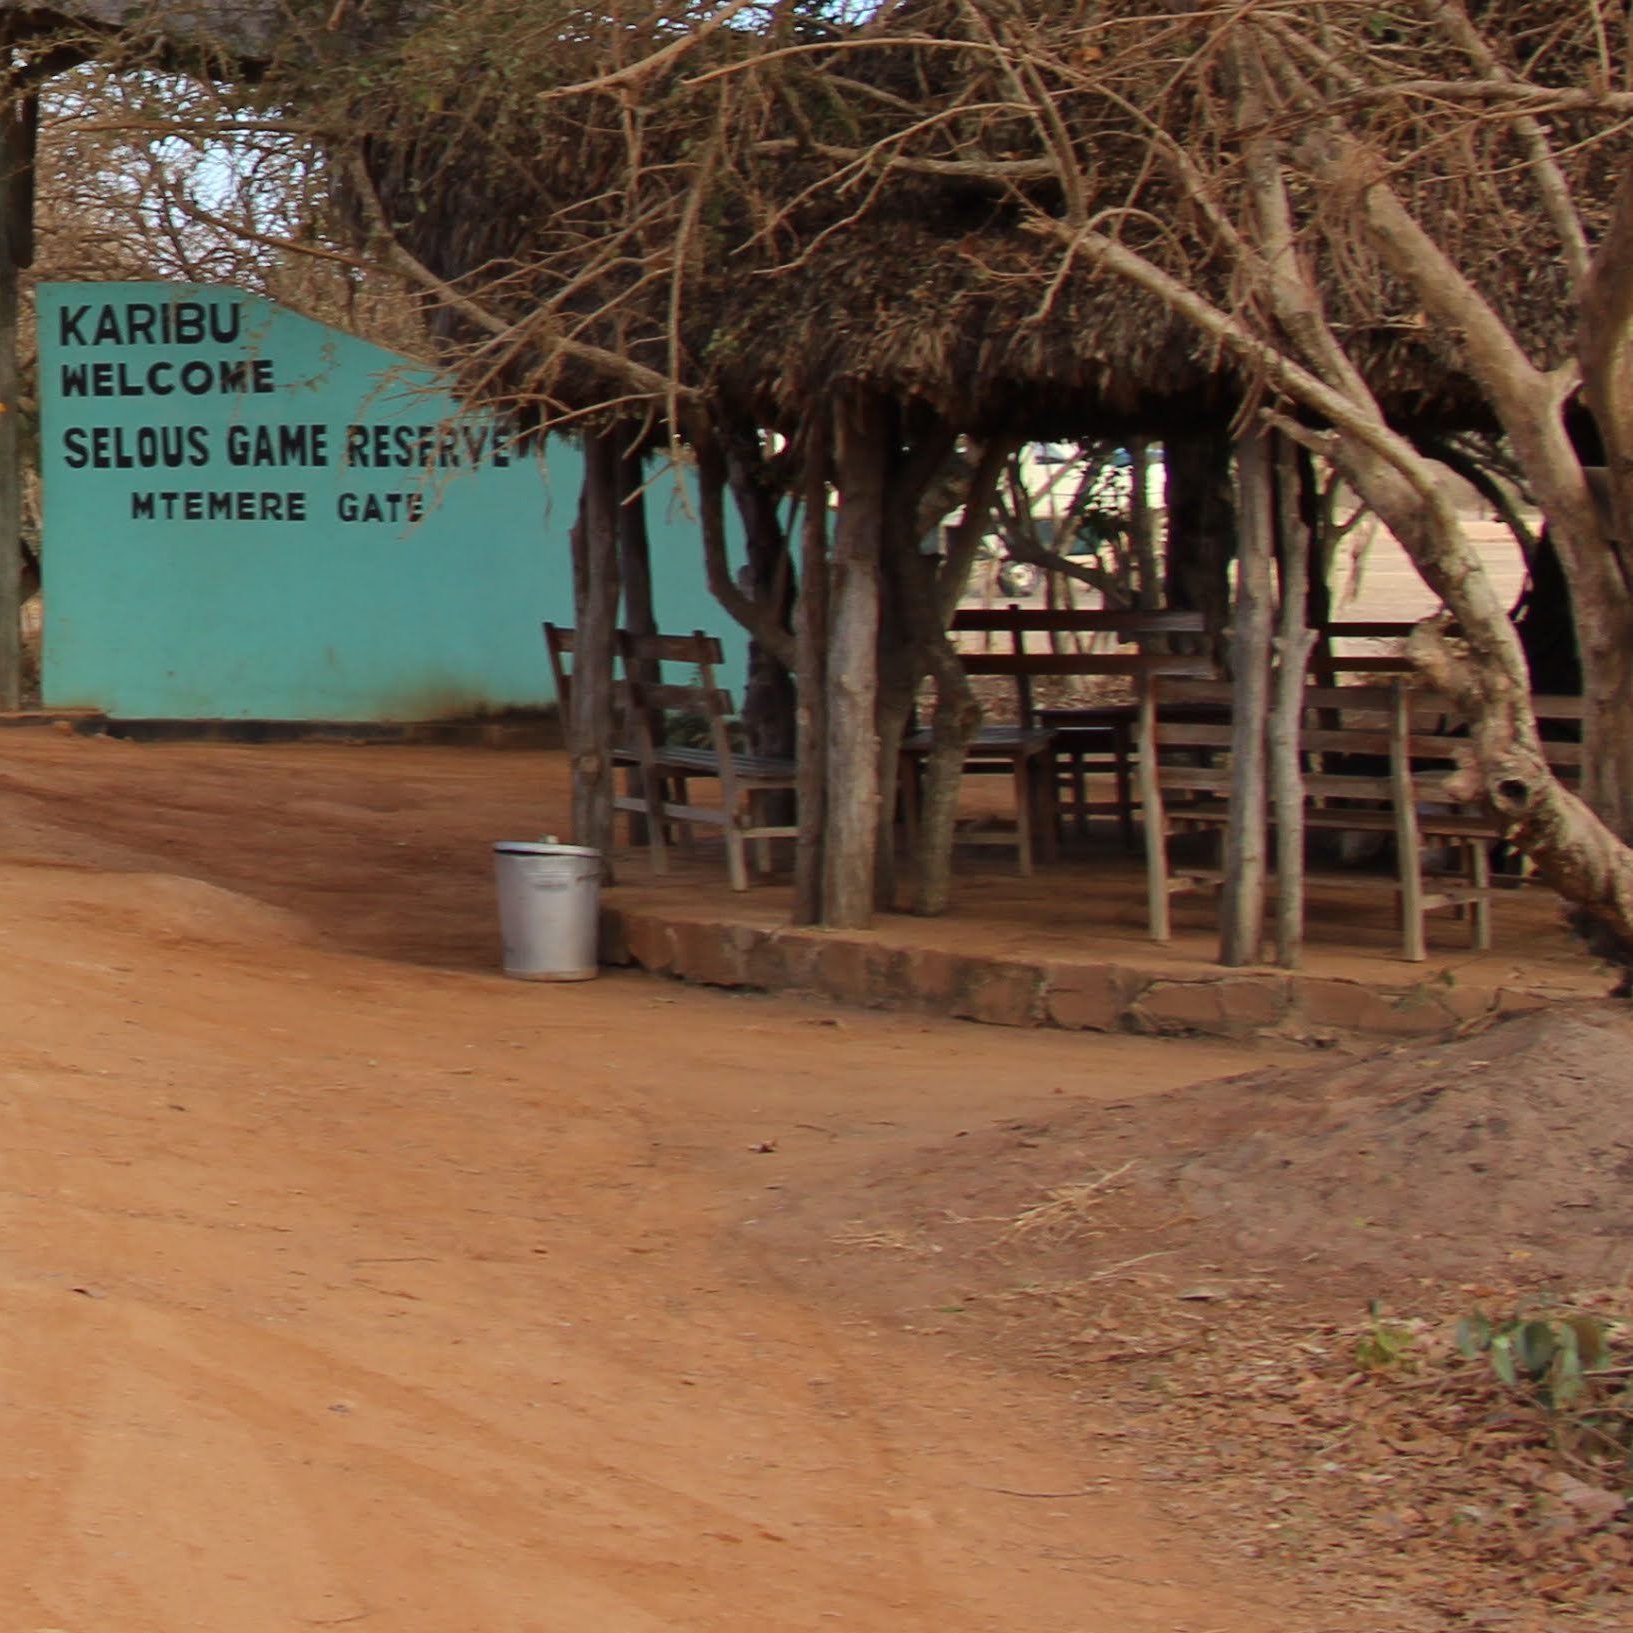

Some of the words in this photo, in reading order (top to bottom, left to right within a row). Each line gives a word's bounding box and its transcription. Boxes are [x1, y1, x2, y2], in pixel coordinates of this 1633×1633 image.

[58, 301, 243, 347] KARIBU
[61, 360, 275, 398] WELCOME
[63, 424, 210, 469] SELOUS
[227, 423, 329, 468] GAME
[346, 423, 511, 469] RESERVE
[131, 491, 307, 522] MTEMERE
[337, 491, 425, 523] GATE
